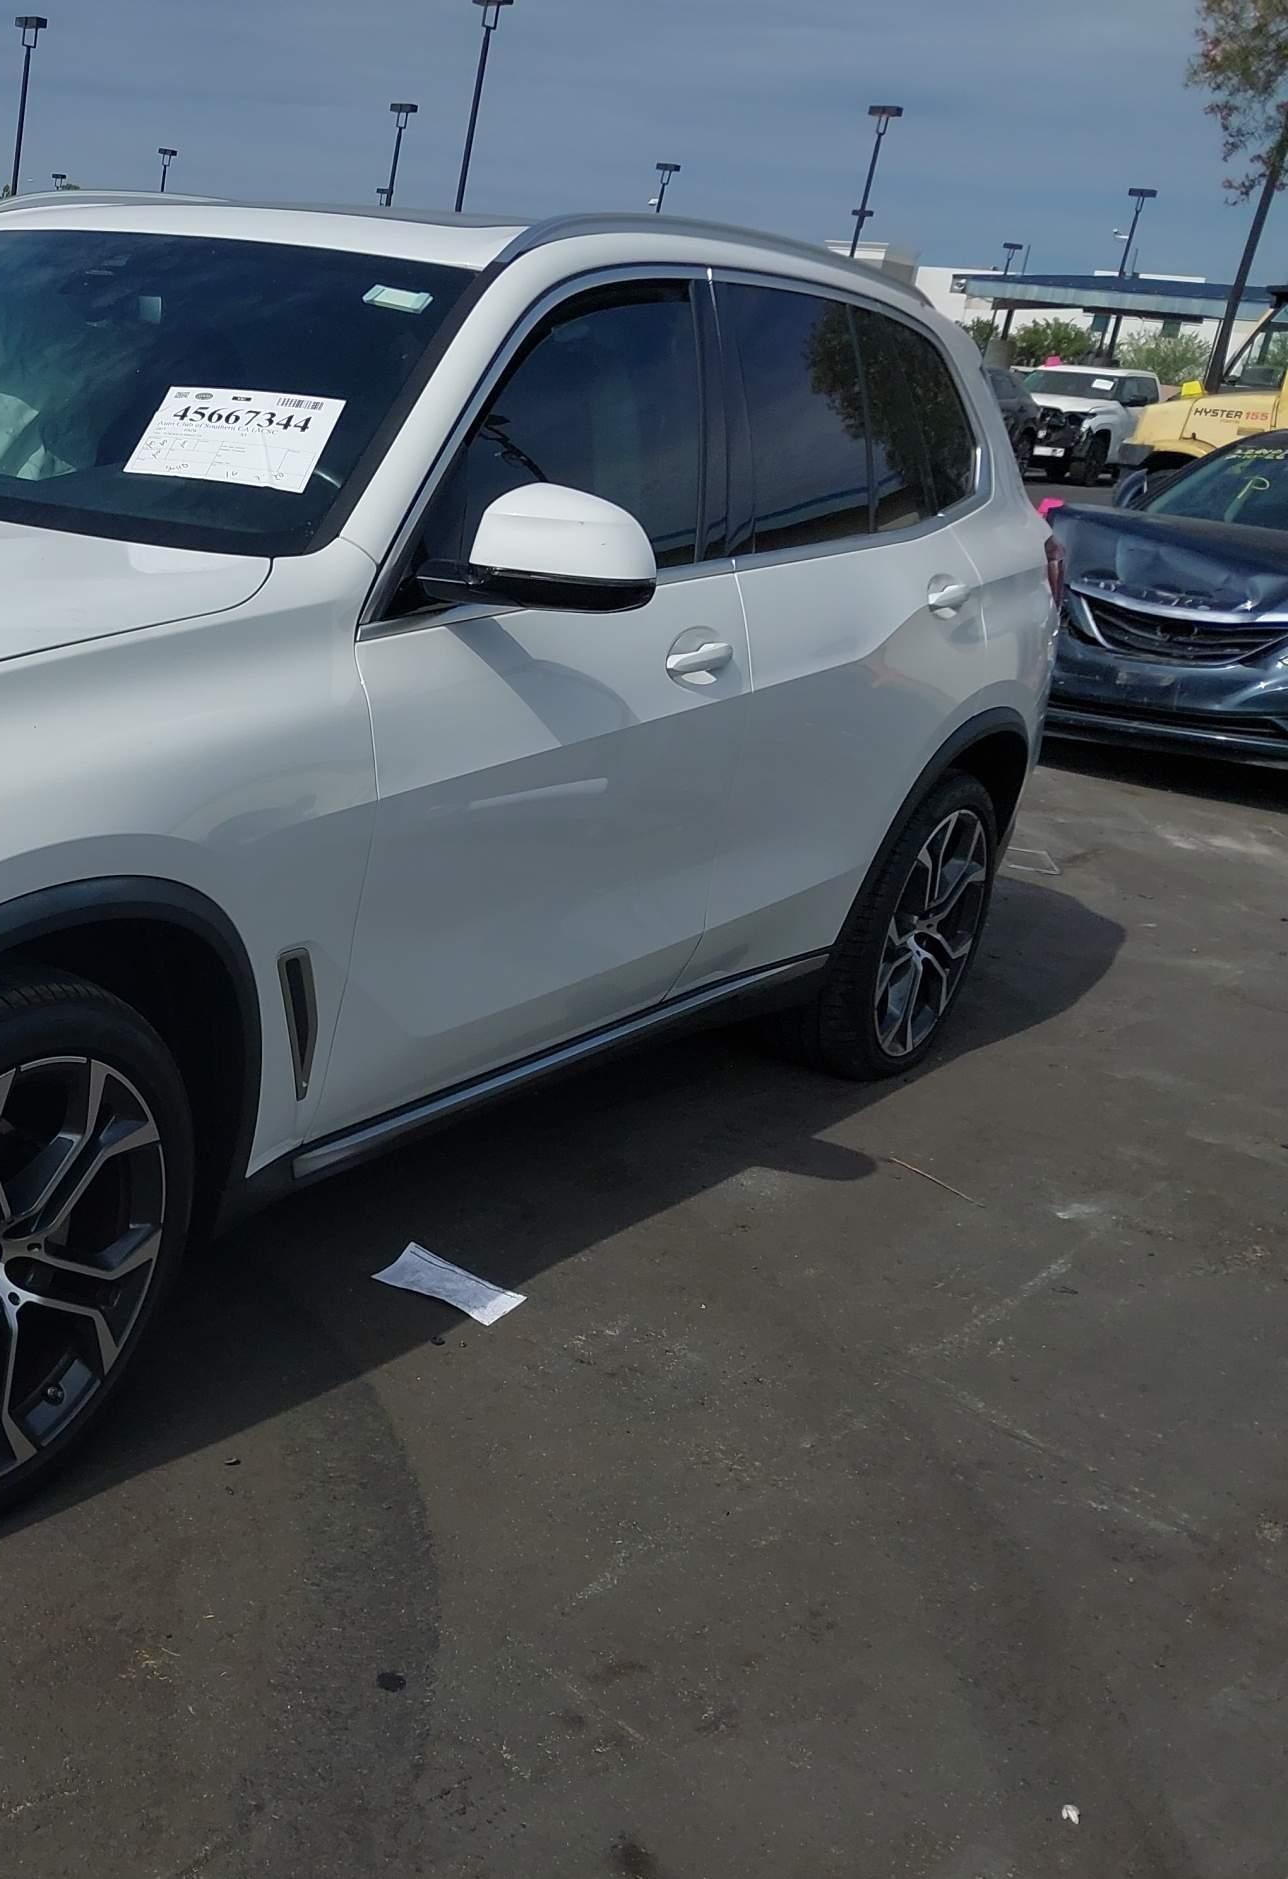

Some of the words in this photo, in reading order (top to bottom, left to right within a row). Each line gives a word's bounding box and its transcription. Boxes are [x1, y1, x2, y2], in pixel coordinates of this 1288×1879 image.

[173, 405, 312, 433] 45667344
[1193, 407, 1243, 419] HYSTER
[1245, 411, 1269, 421] 155
